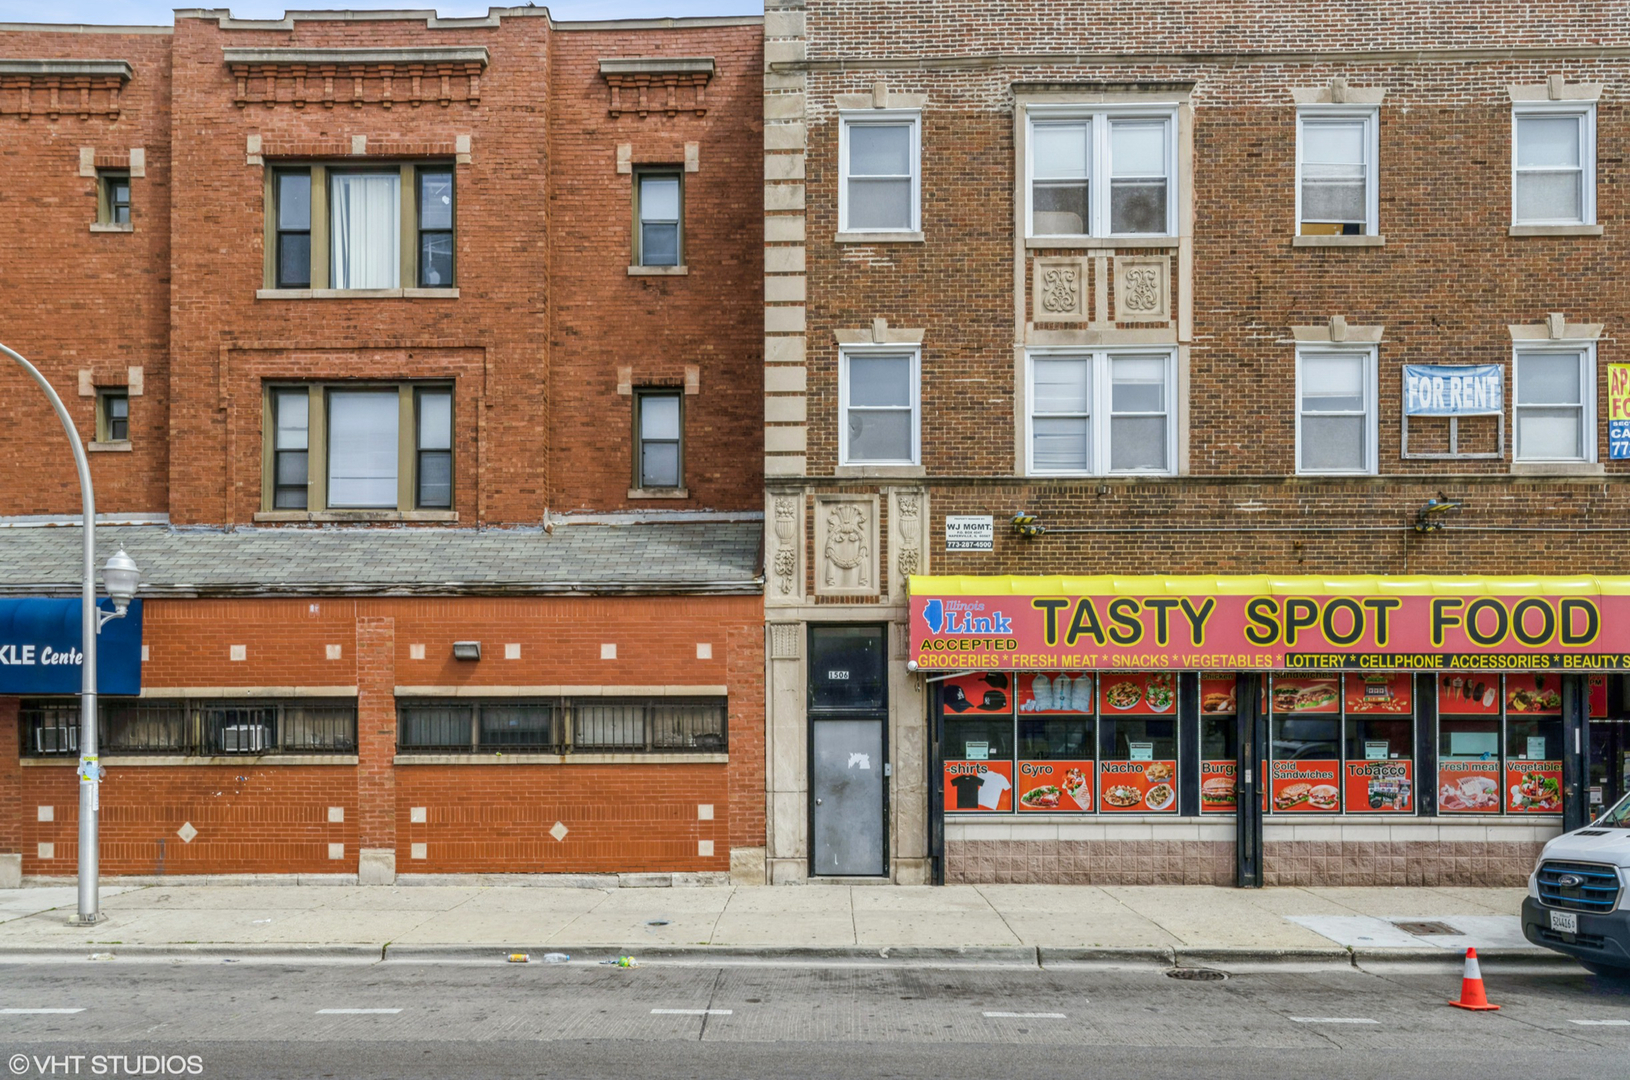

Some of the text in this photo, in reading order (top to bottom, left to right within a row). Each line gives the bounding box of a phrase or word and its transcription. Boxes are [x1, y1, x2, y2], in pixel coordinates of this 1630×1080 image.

[1611, 367, 1630, 396] AP
[1408, 376, 1499, 409] FOR RENT
[1611, 441, 1630, 456] 77
[945, 600, 985, 611] Illinois
[945, 611, 1013, 634] Link
[1031, 597, 1601, 647] TASTY SPOT FOOD
[920, 638, 1018, 652] ACCEPTED
[41, 646, 83, 665] Cente
[918, 654, 999, 668] GROCERIES
[1012, 654, 1057, 668] FRESH
[1061, 654, 1098, 668] MEAT
[1111, 654, 1169, 668] SNACKS
[1182, 654, 1273, 668] VEGETABLES
[1286, 654, 1346, 668] LOTTERY
[1359, 654, 1443, 668] CELLPHONE
[1450, 654, 1550, 668] ACCESSORIES
[1563, 655, 1619, 668] BEAUTY
[829, 671, 849, 679] 1506
[1201, 672, 1233, 680] Chicken
[944, 762, 988, 774] -shirts
[1021, 763, 1053, 777] Gyro
[1101, 762, 1143, 773] Nacho
[1273, 762, 1296, 771] Cold
[1348, 764, 1406, 776] Tobacco
[1440, 762, 1498, 771] Fresh meat
[1273, 770, 1334, 779] Sandwiches
